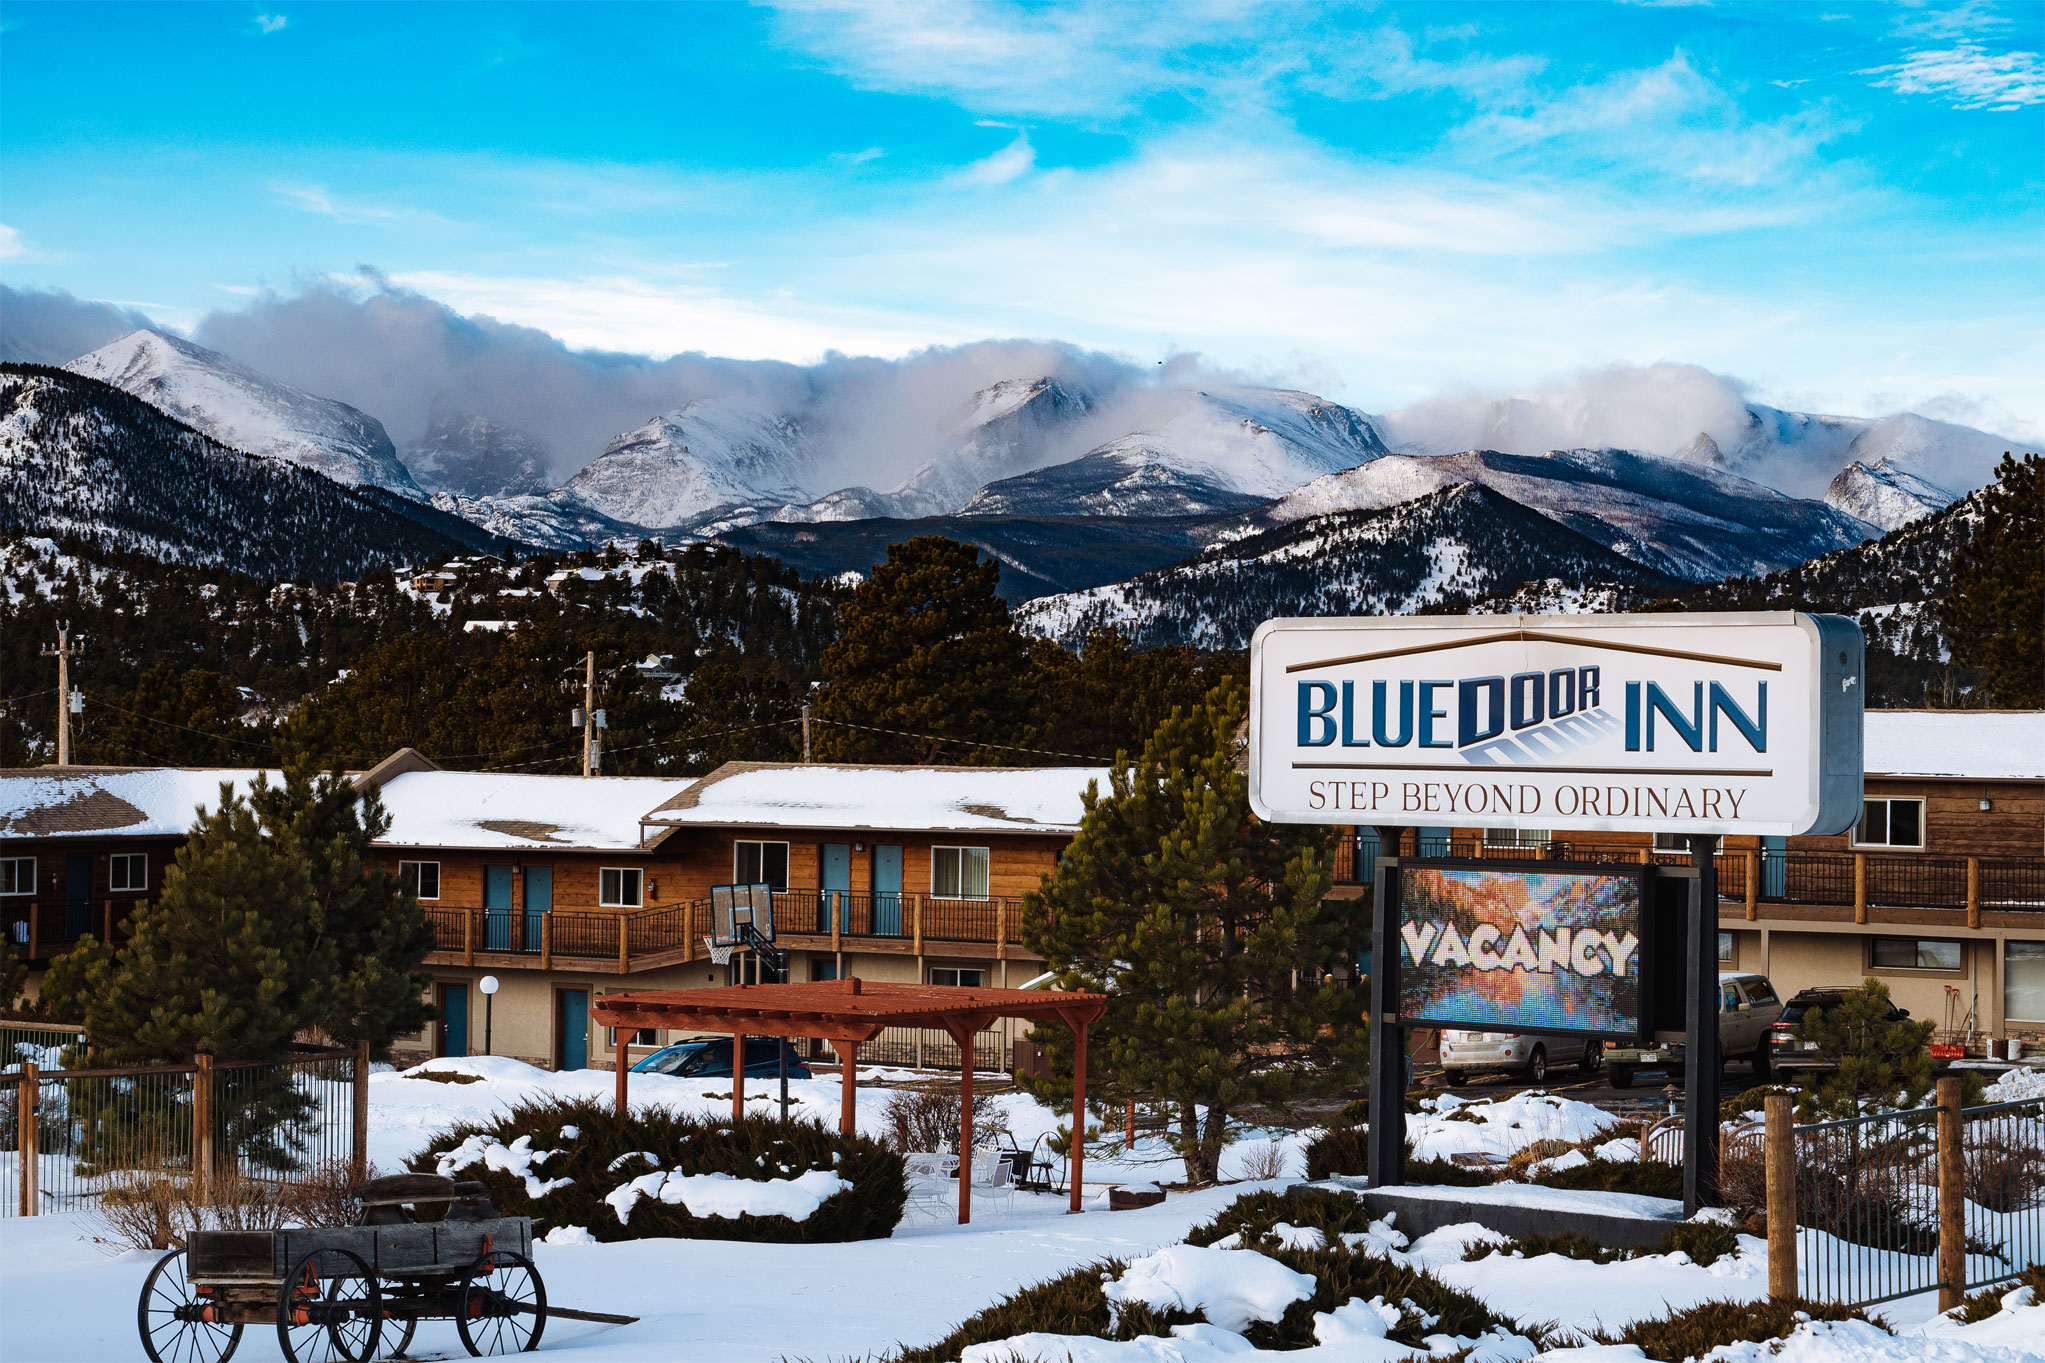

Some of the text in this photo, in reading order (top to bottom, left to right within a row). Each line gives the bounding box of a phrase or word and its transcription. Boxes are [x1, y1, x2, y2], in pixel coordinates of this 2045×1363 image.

[1624, 679, 1768, 754] INN
[1308, 780, 1749, 819] STEP BEYOND ORDINARY
[1400, 919, 1639, 977] VACANCY
